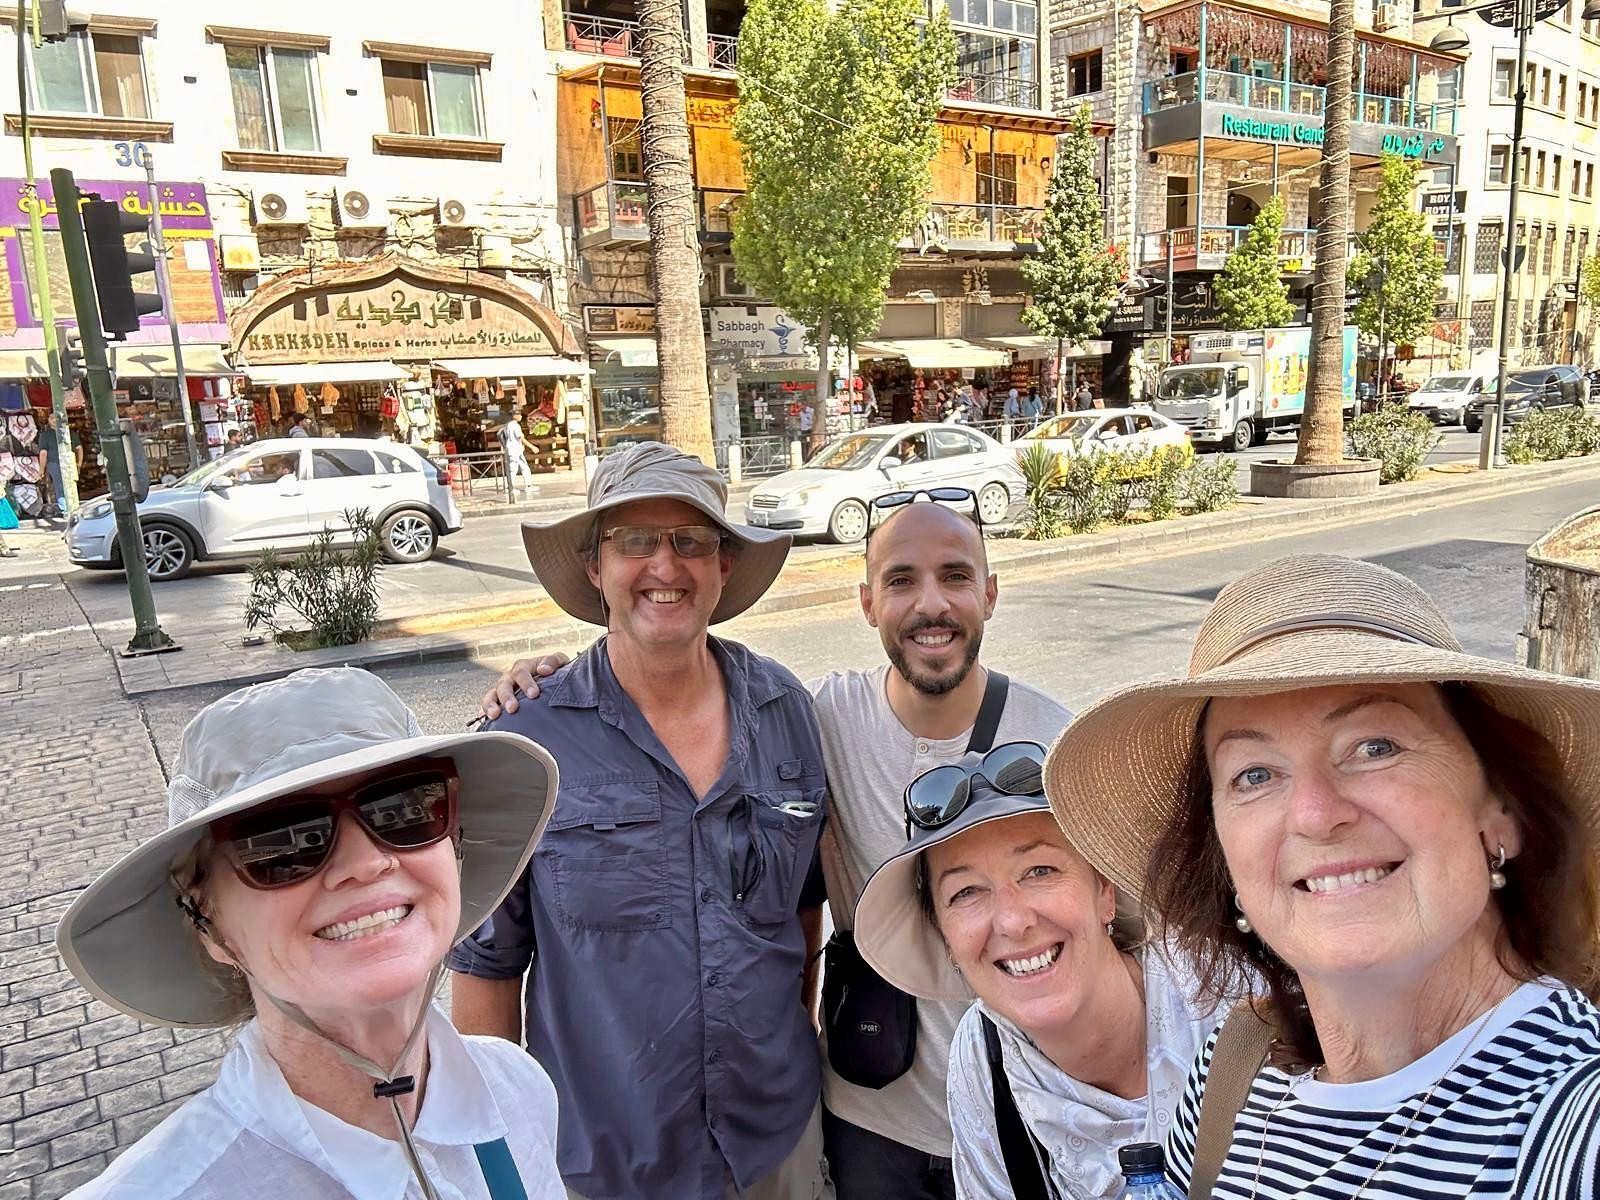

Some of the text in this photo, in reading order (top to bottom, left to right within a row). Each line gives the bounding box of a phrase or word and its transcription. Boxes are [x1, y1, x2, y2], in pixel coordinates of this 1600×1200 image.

[1223, 112, 1292, 140] Restaurant
[115, 143, 148, 167] 30
[717, 320, 765, 334] Sabbagh
[248, 332, 350, 351] KARKADEH
[353, 340, 390, 350] Spices
[406, 339, 437, 348] Herbs
[720, 338, 766, 350] Pharmacy
[860, 1023, 878, 1032] SPORT
